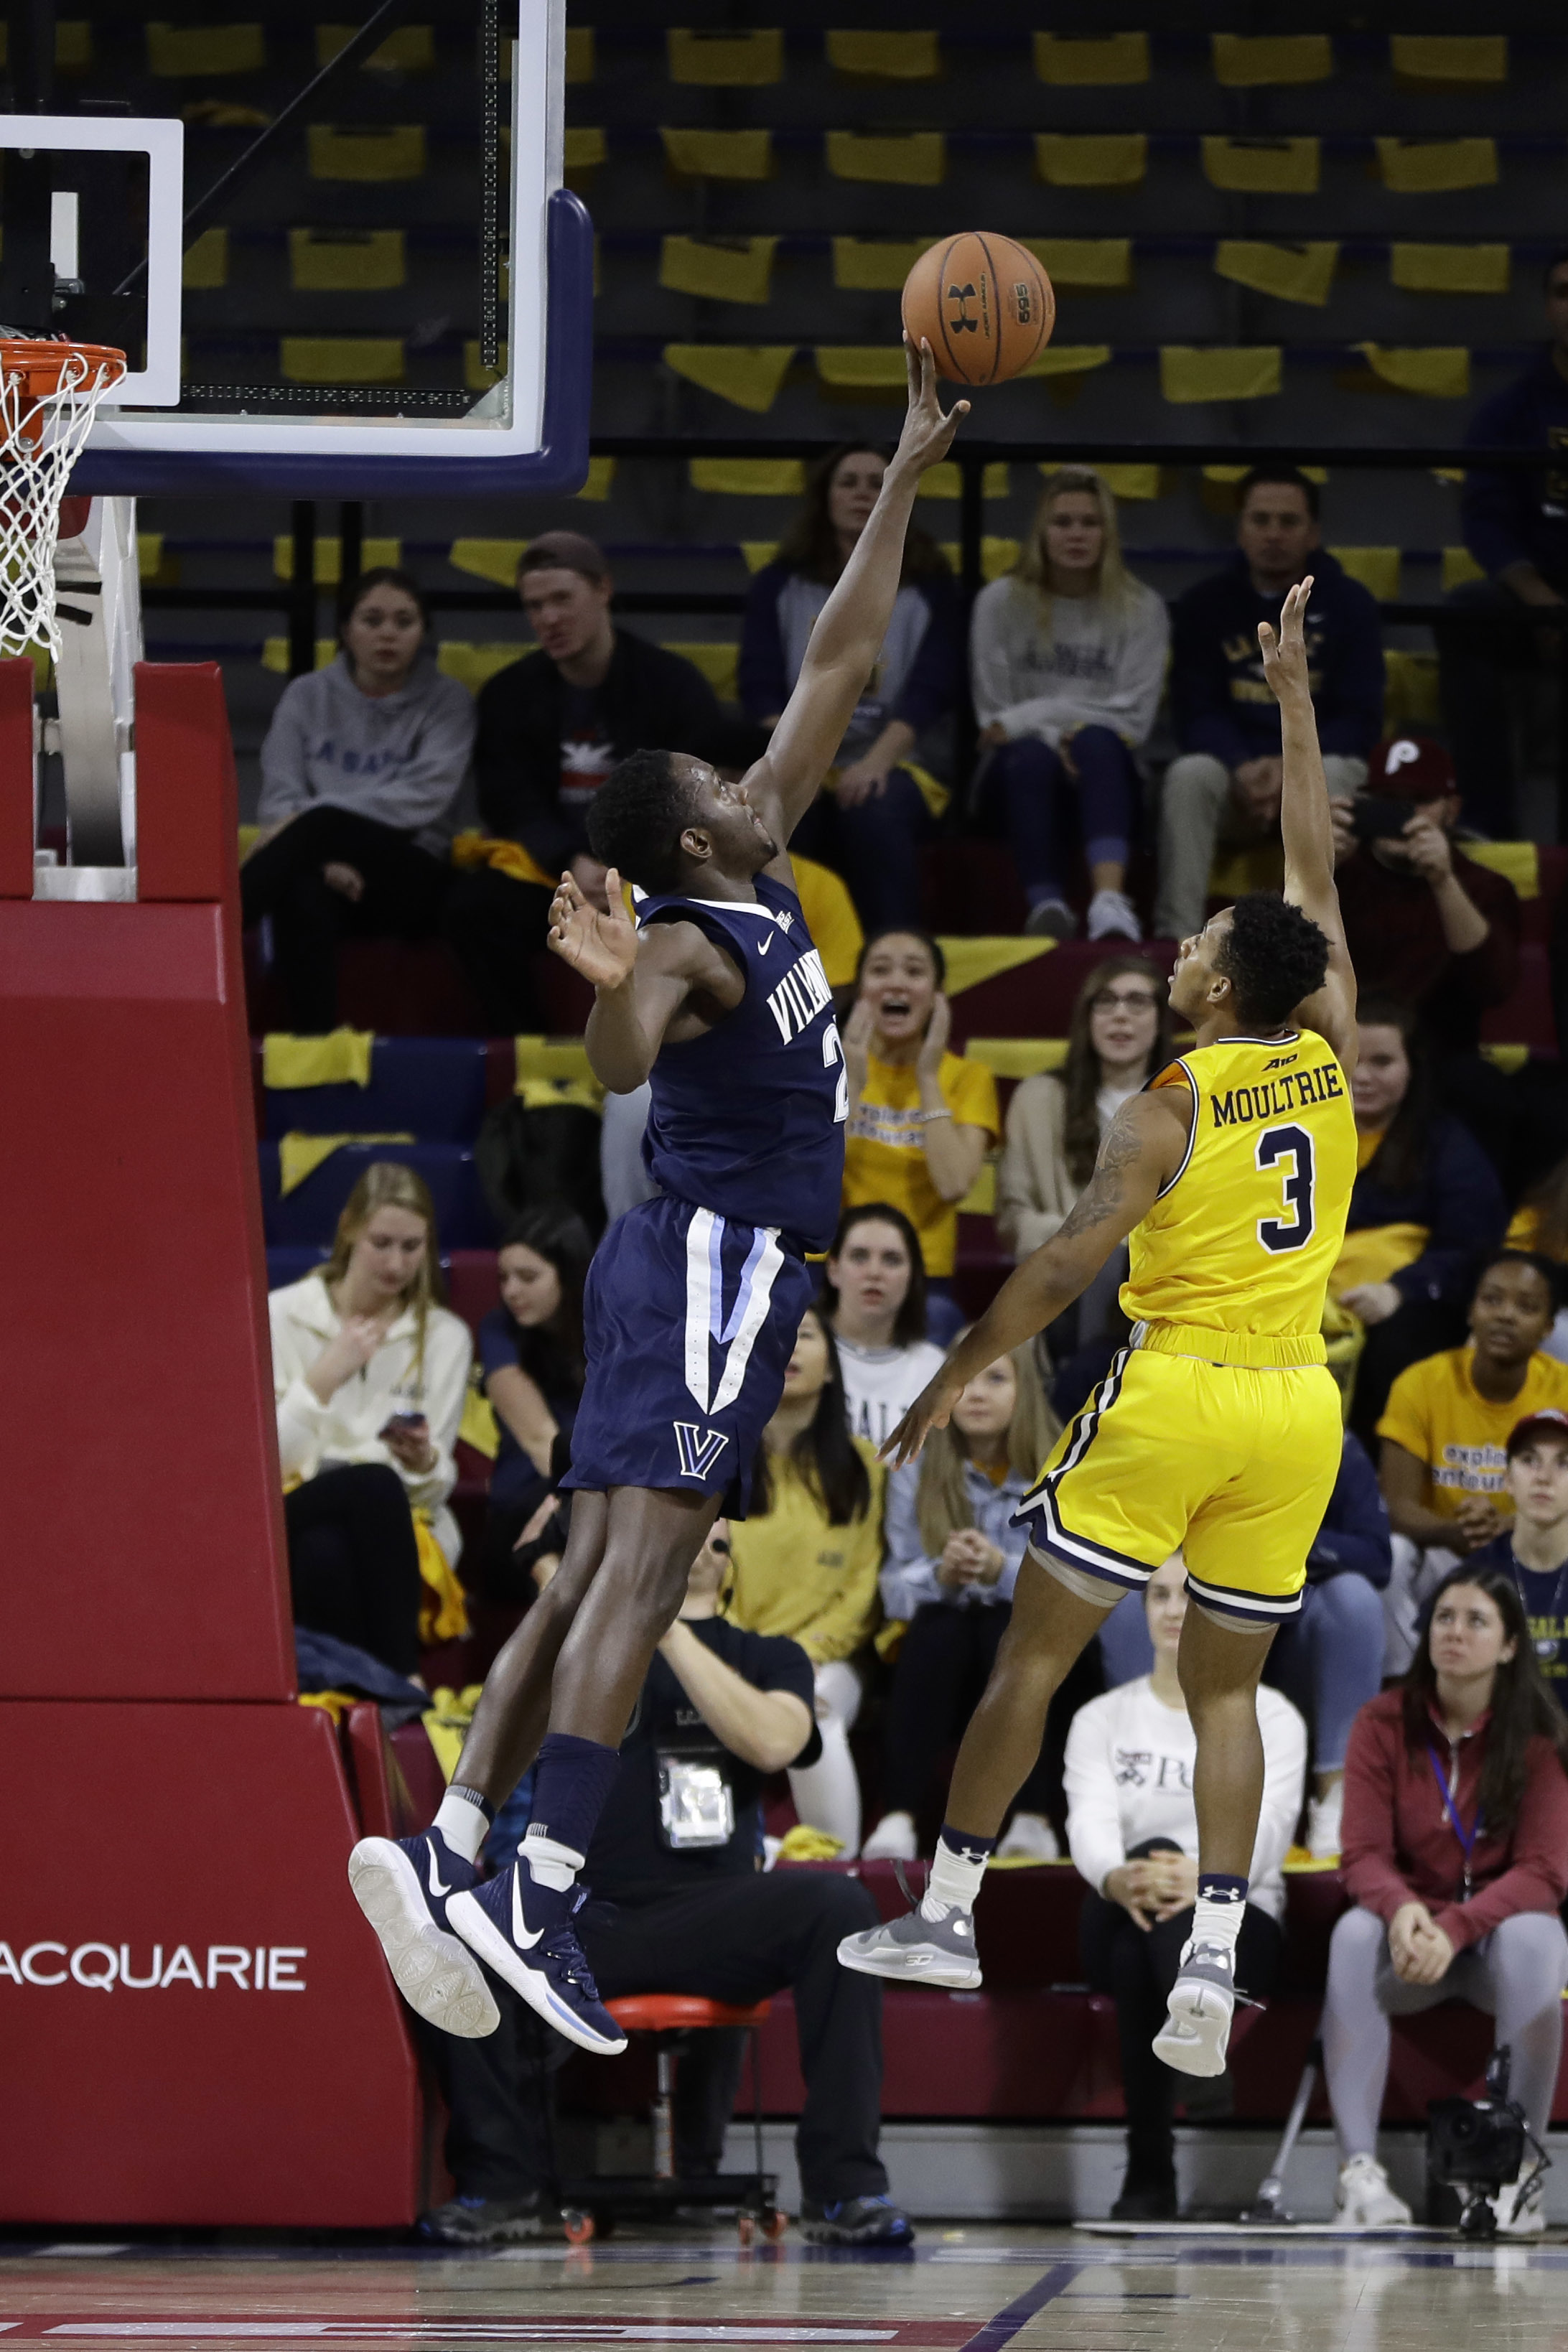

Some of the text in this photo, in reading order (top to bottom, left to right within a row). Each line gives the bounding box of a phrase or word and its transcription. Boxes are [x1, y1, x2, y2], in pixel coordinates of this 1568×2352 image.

[1385, 739, 1419, 775] P
[1210, 1063, 1343, 1128] MOULTRIE
[1254, 1121, 1316, 1255] 3
[673, 1422, 729, 1480] V
